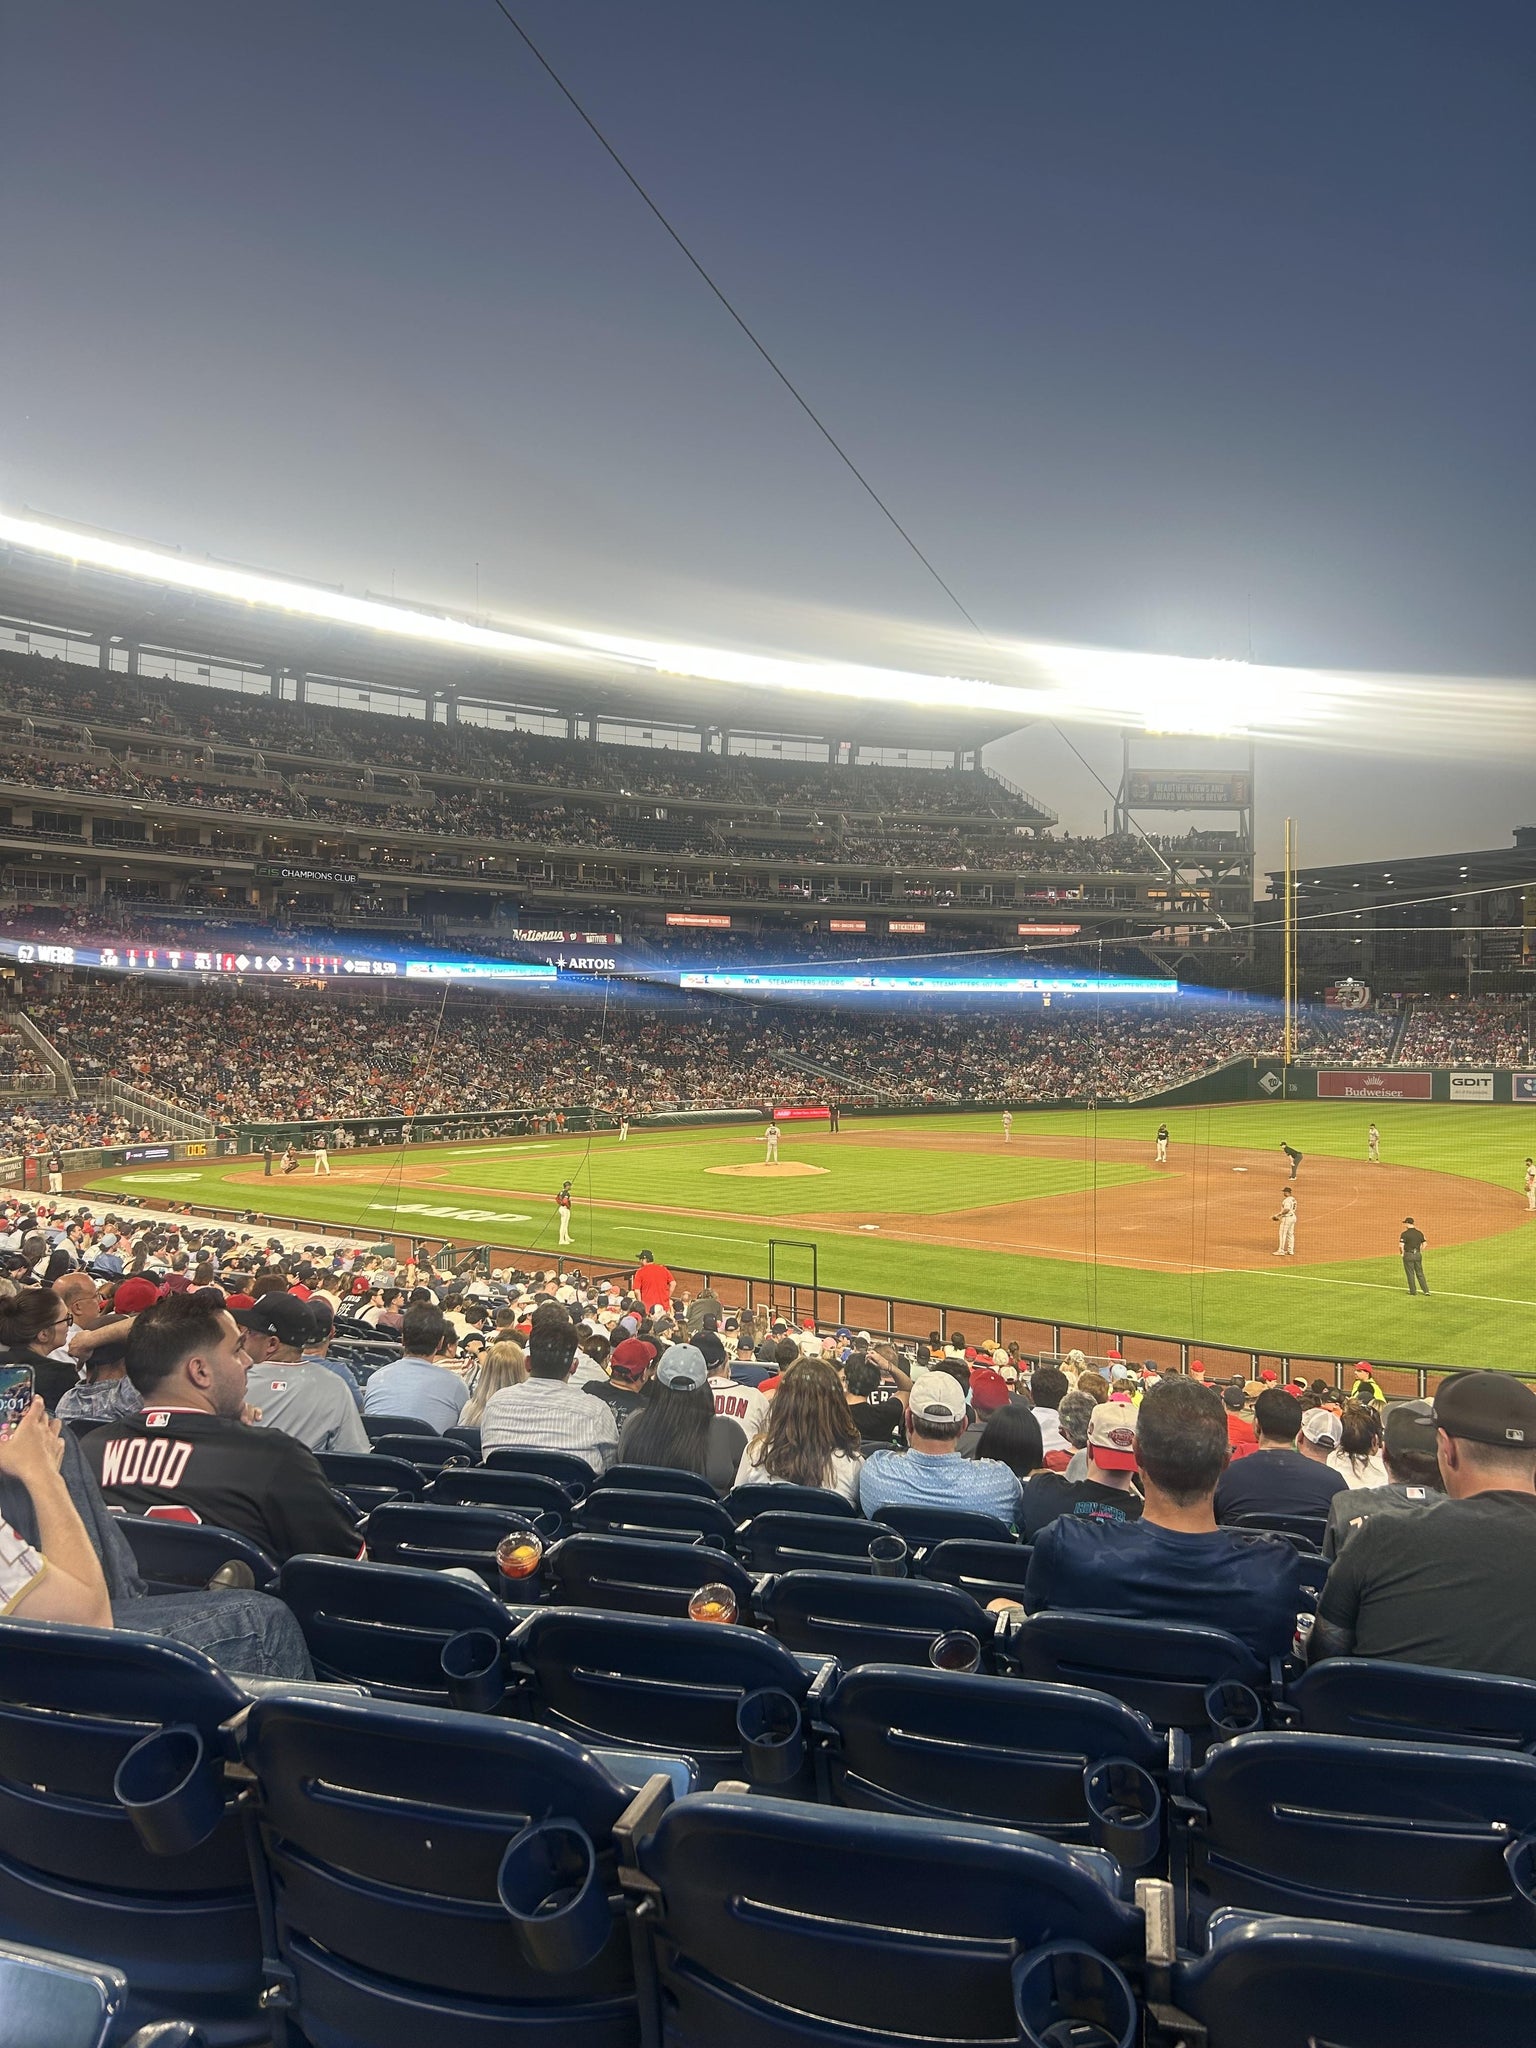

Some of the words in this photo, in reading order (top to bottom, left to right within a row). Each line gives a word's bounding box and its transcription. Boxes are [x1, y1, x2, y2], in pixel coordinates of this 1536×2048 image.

[281, 869, 333, 881] CHAMPIONS
[334, 873, 356, 882] CLUB
[37, 946, 74, 964] WEBB
[286, 957, 295, 971] 3
[569, 958, 616, 970] ARTOIS
[1451, 1078, 1492, 1086] GDIT
[102, 1437, 194, 1489] WOOD
[1074, 1501, 1098, 1514] IRON
